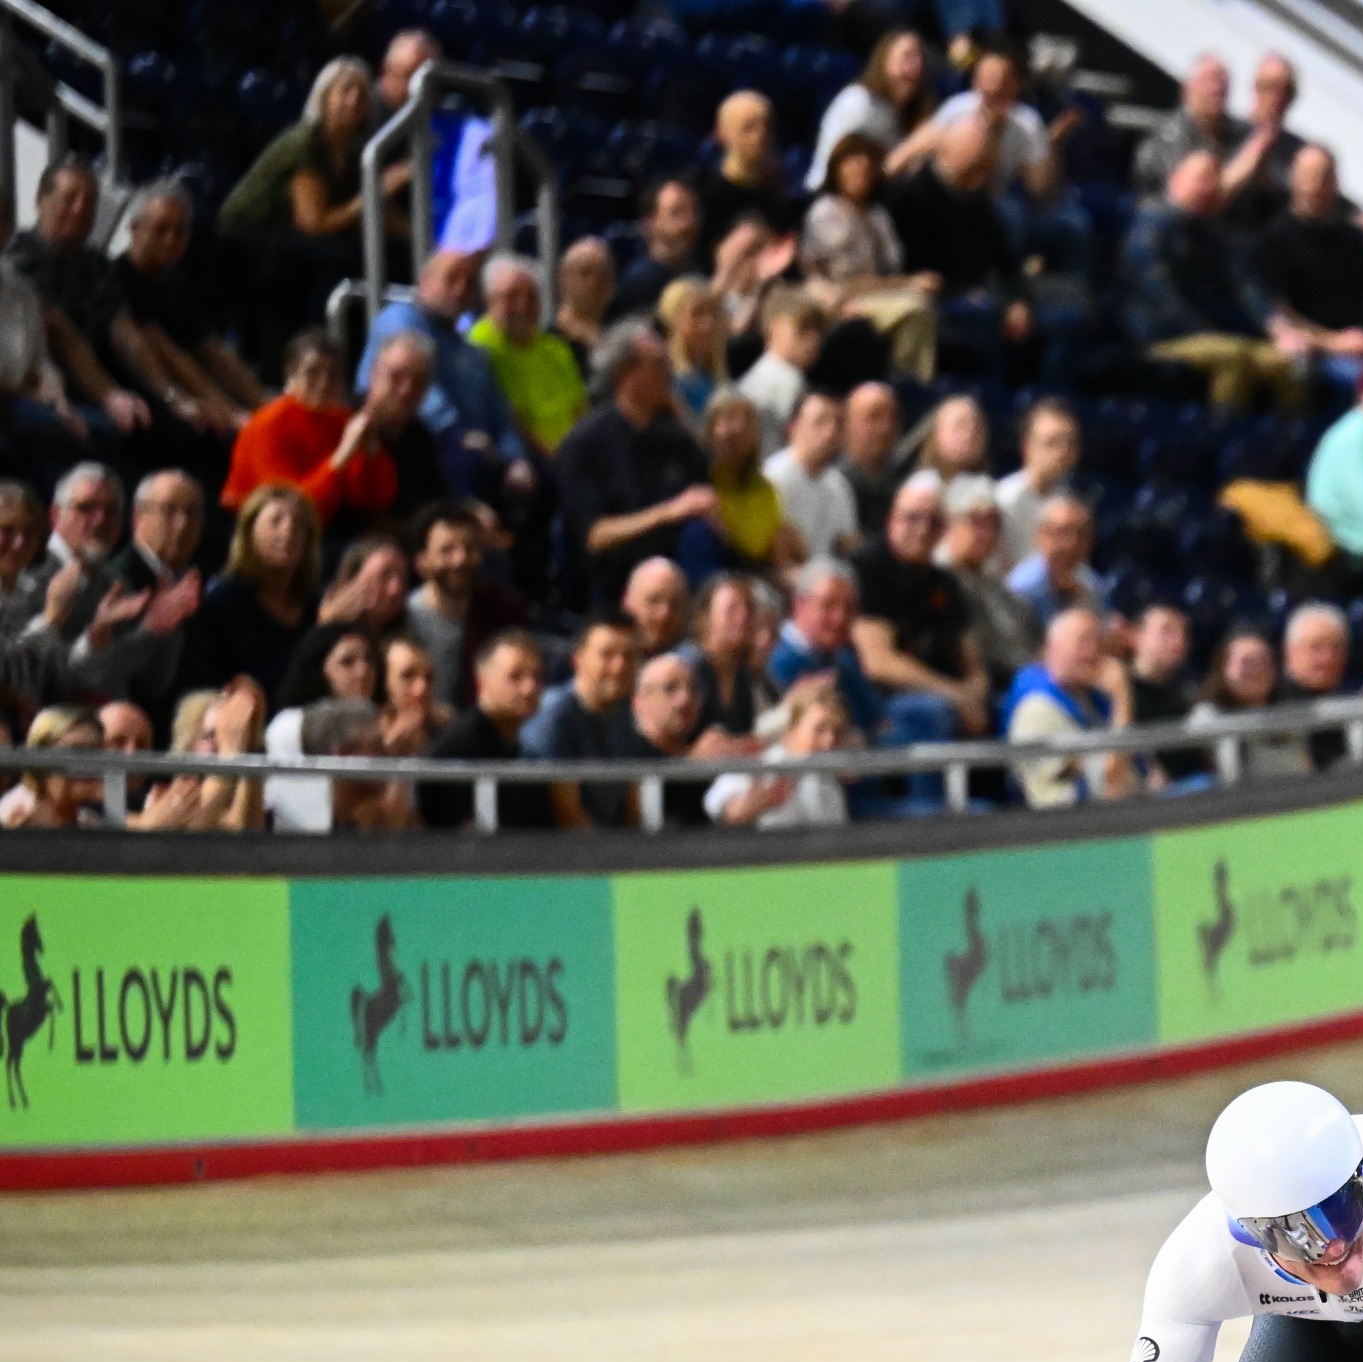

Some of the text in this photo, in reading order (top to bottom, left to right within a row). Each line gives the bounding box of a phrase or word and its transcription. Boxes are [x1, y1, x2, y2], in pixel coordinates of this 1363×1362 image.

[420, 956, 567, 1052] LLOYDS
[726, 940, 856, 1034] LLOYDS
[1001, 908, 1117, 1005] LLOYDS
[71, 965, 236, 1065] LLOYDS
